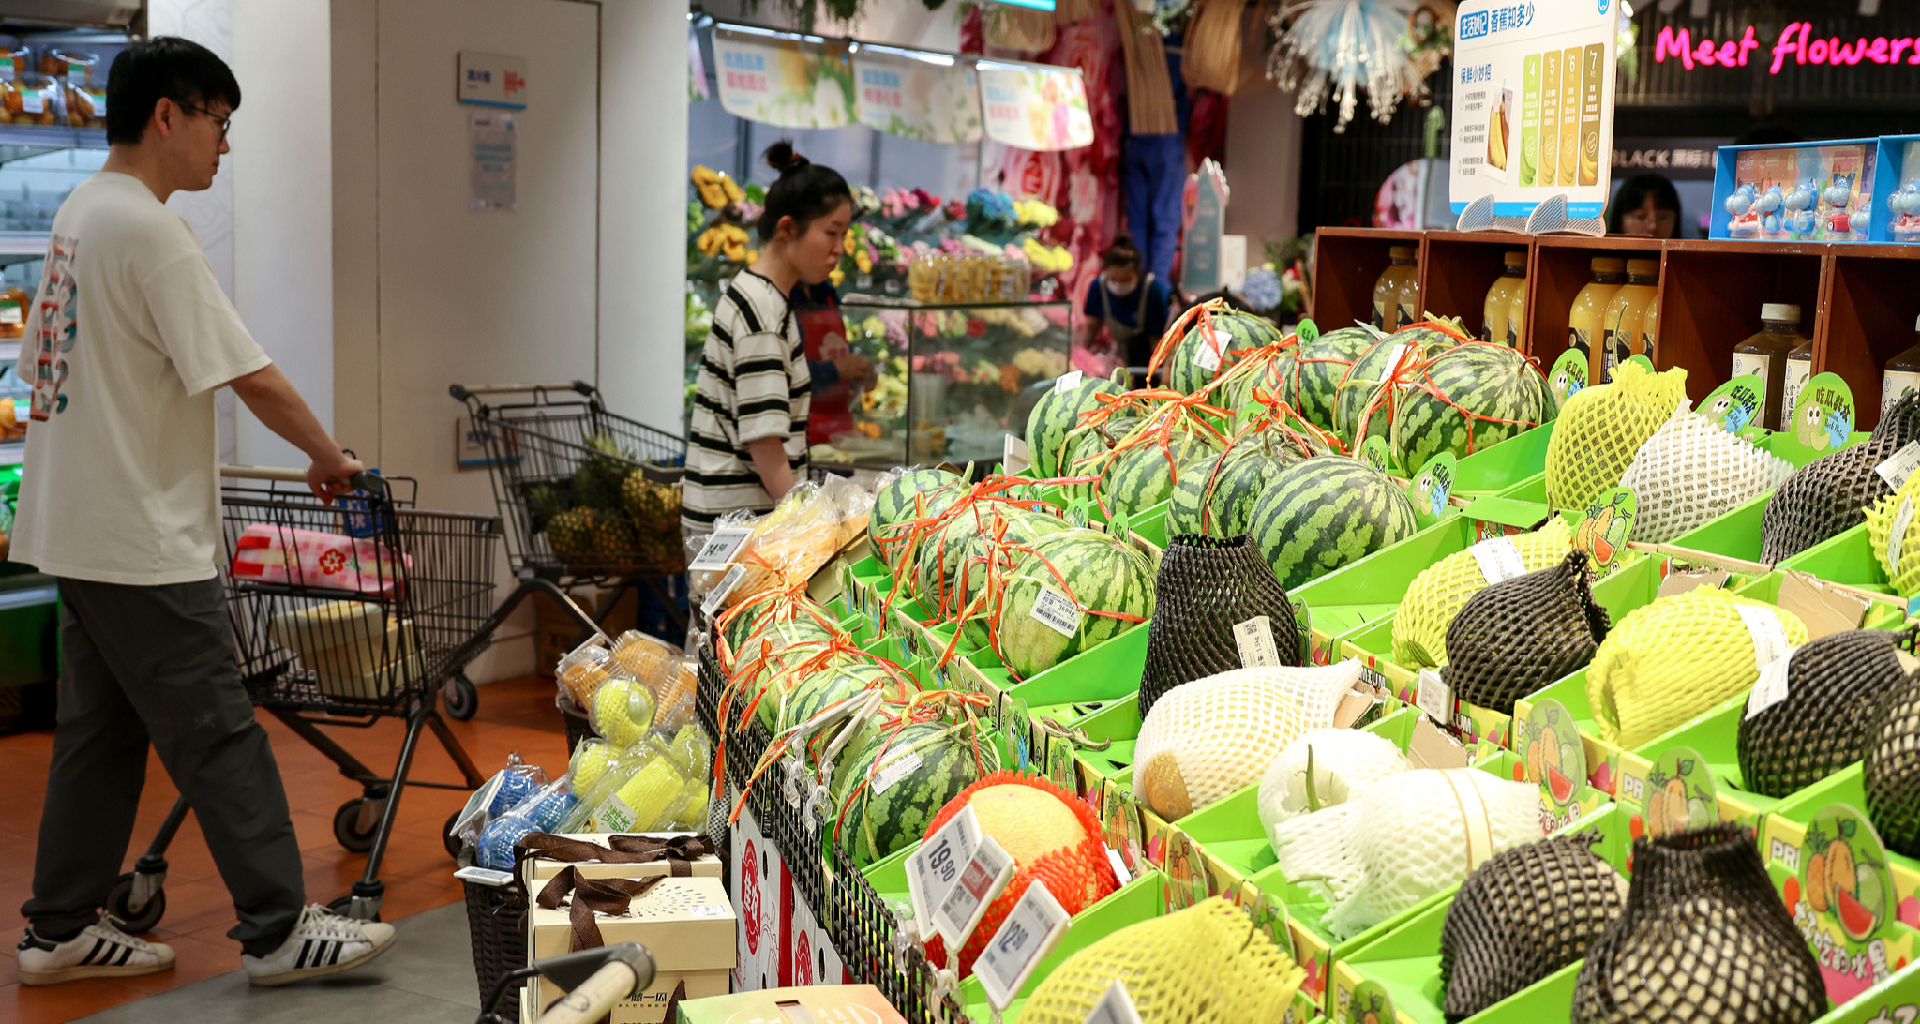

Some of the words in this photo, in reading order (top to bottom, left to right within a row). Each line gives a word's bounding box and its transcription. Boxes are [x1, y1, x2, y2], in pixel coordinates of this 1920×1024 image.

[1461, 12, 1488, 39] 生活妙记
[1491, 1, 1535, 33] 香蕉知多少
[1655, 25, 1759, 70] Meet
[1769, 22, 1920, 75] flowers
[1461, 63, 1492, 85] 保鲜小妙招
[1816, 386, 1851, 423] 吃瓜群众
[1793, 900, 1891, 986] 好吃的水果
